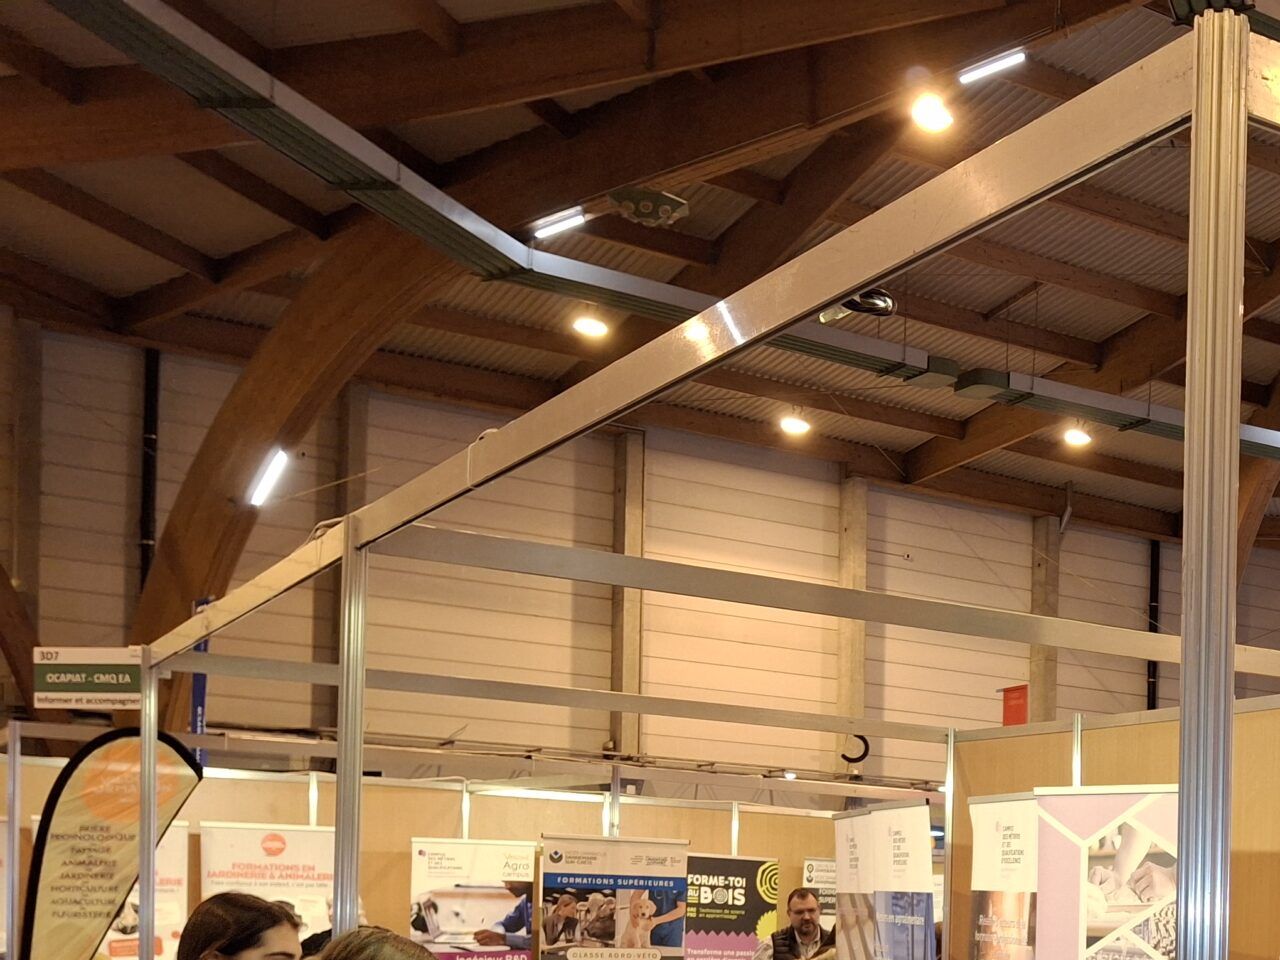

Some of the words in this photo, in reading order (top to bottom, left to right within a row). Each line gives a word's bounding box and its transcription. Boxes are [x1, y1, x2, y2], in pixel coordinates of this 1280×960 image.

[40, 651, 59, 661] 3D7
[46, 673, 87, 683] OCAPIAT
[503, 861, 529, 871] Agro
[277, 873, 333, 881] ANIMALERI
[557, 877, 614, 885] FORMATIONS
[617, 878, 674, 887] SUPÉRIEURES
[687, 874, 746, 887] FORME-TOI
[687, 889, 699, 897] AU
[700, 887, 745, 906] BOIS
